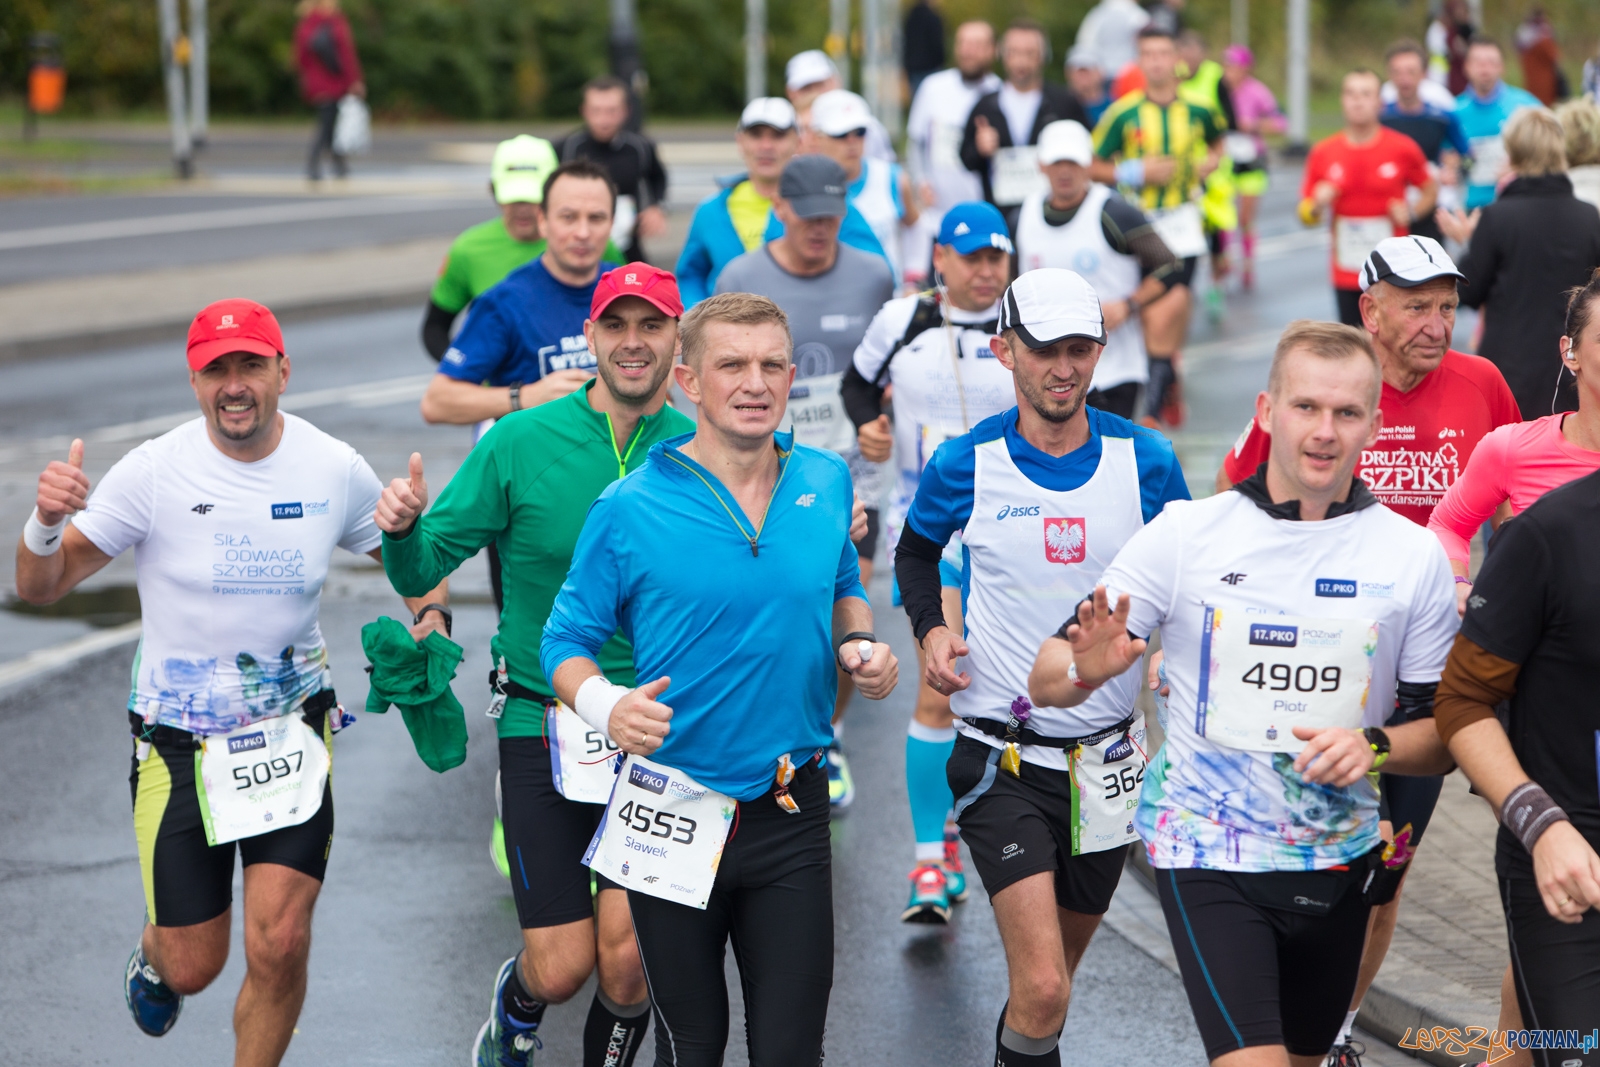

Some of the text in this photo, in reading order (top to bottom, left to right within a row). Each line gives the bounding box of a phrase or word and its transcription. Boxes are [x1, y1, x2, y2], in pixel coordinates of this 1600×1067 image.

[1360, 447, 1444, 467] DRUŻYNA
[1360, 466, 1459, 491] SZPIKU
[795, 493, 817, 508] 4F
[191, 504, 215, 515] 4F
[1010, 506, 1040, 517] asics
[214, 533, 252, 547] SIŁA
[225, 549, 304, 562] ODWAGA
[212, 563, 305, 578] SZYBKOŚĆ
[1220, 572, 1247, 585] 4F
[212, 586, 220, 594] 9
[284, 586, 305, 595] 2016
[1241, 662, 1342, 692] 4909
[1273, 700, 1308, 712] Piotr
[1077, 728, 1119, 744] performance
[233, 750, 303, 790] 5097
[248, 780, 302, 804] Sylwester
[668, 788, 702, 802] maraton
[1126, 798, 1140, 810] Da
[618, 800, 697, 845] 4553
[624, 835, 668, 859] Sławek
[643, 875, 659, 884] 4F
